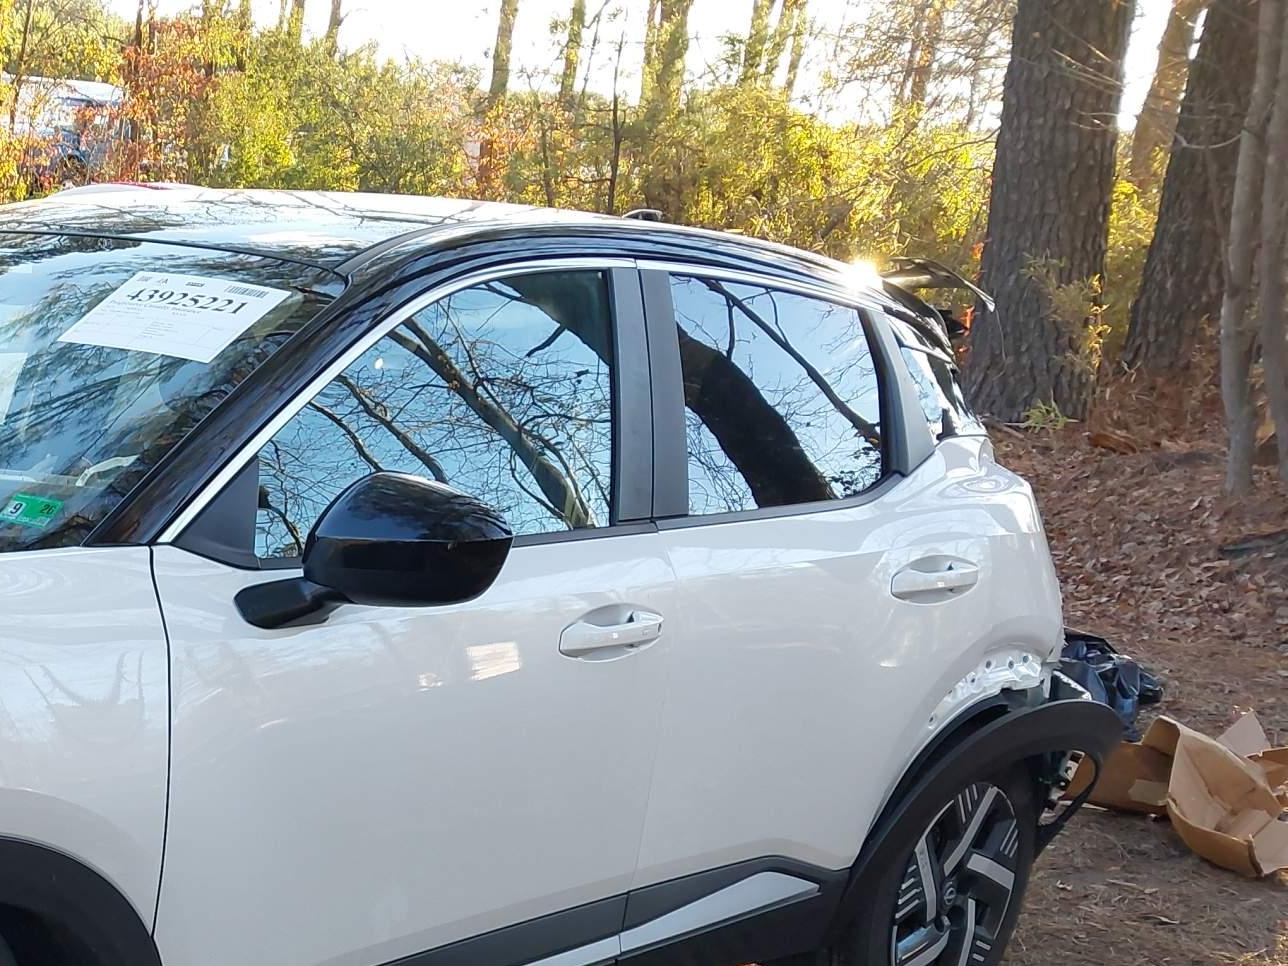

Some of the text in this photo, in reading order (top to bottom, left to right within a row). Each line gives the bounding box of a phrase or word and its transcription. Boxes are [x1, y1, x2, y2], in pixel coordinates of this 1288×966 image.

[127, 288, 248, 314] 43925221
[9, 502, 56, 514] 9 26
